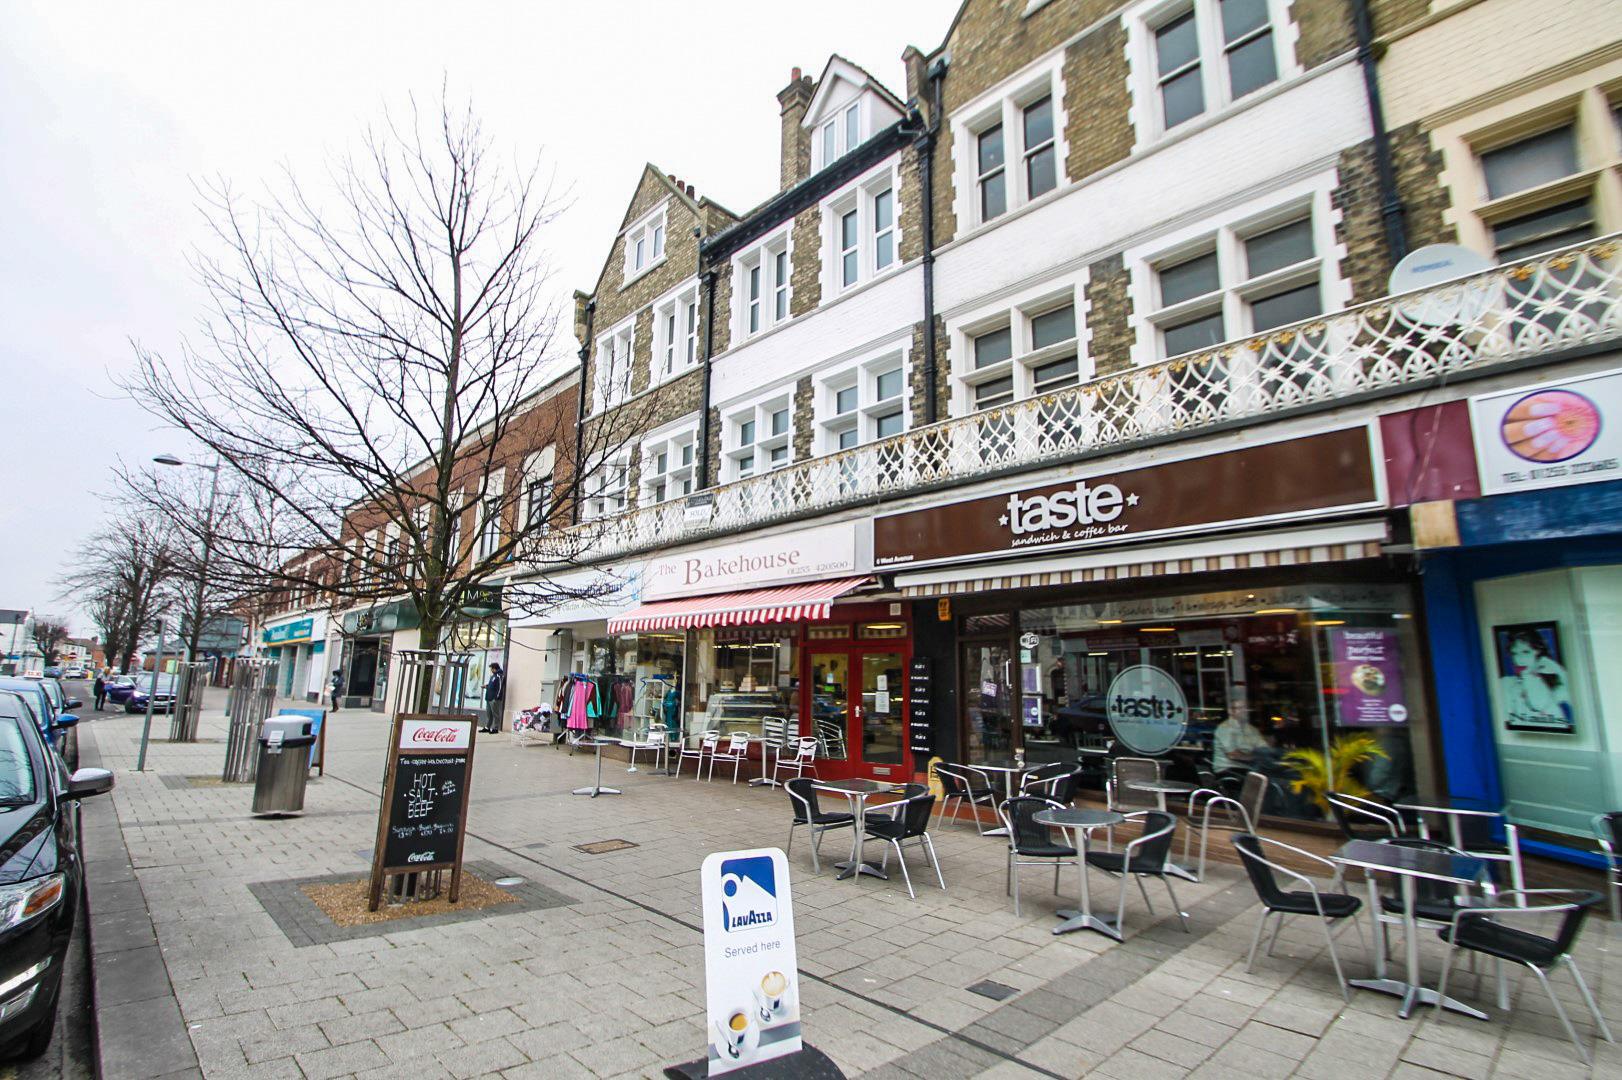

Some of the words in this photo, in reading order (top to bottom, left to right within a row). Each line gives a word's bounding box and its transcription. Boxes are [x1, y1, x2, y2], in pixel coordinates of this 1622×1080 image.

[1007, 481, 1123, 534] taste
[1012, 533, 1060, 547] sandwich
[1062, 530, 1071, 540] &
[1074, 526, 1105, 539] coffee
[1108, 523, 1129, 534] bar
[658, 563, 677, 576] The
[682, 549, 800, 585] Bakehouse
[815, 560, 849, 573] 420500
[1116, 694, 1175, 719] taste
[413, 773, 436, 789] HOT
[408, 788, 436, 804] SALT
[407, 801, 434, 819] BEEF
[732, 909, 773, 928] LAVAZZA
[724, 943, 758, 959] Served
[760, 940, 781, 951] here
